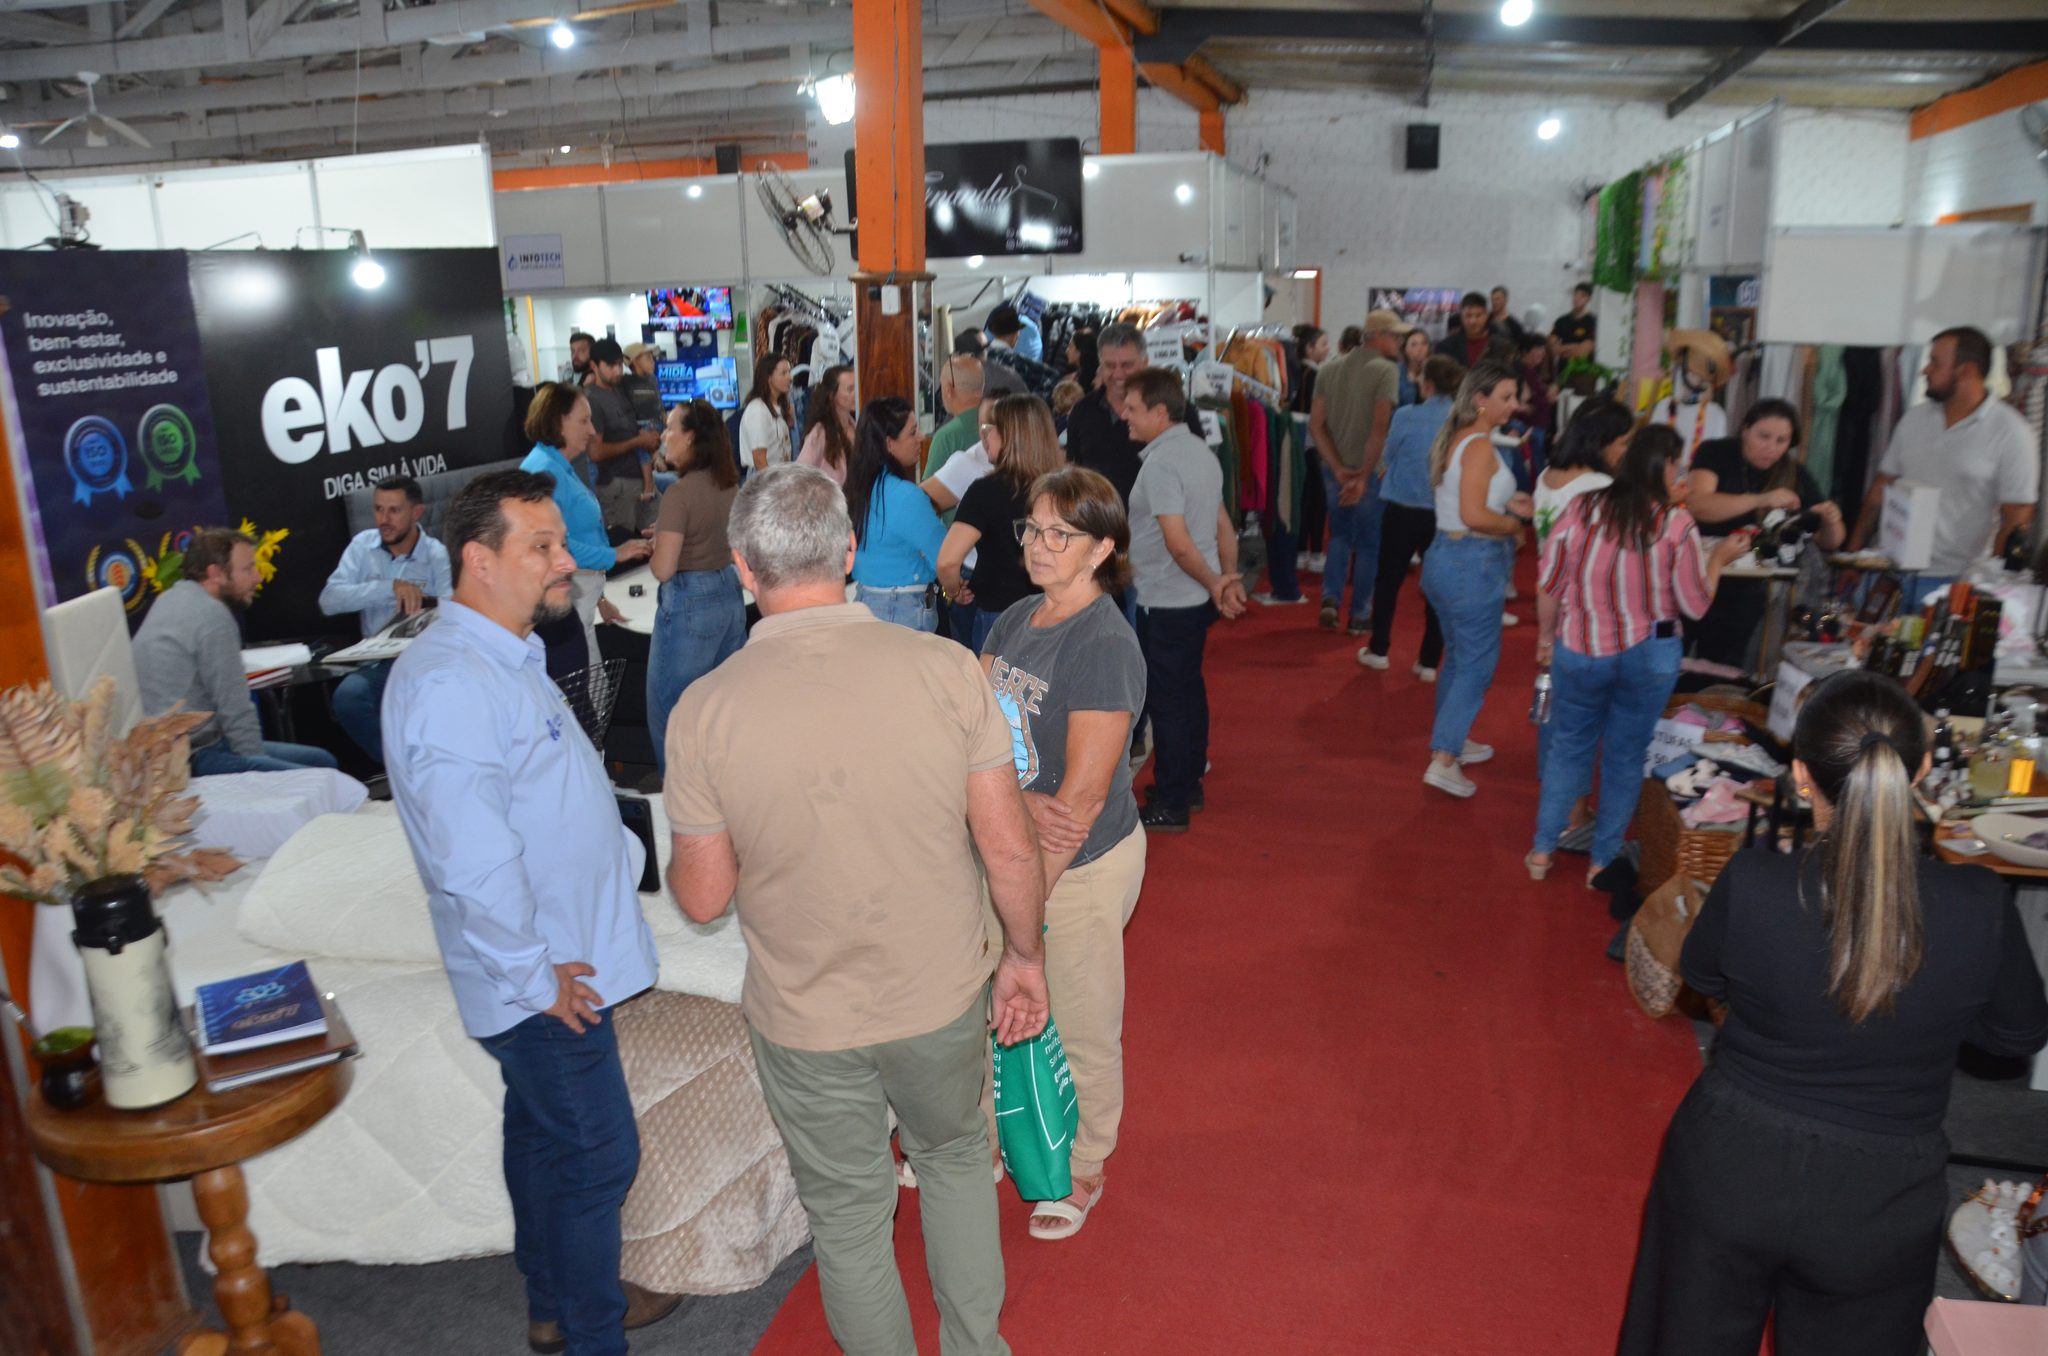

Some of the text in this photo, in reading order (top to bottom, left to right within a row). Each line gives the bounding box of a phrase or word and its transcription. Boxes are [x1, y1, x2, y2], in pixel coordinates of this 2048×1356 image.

[519, 252, 561, 263] INFOTECH
[23, 309, 114, 330] Inovação,
[27, 332, 126, 352] bem-estar,
[33, 350, 167, 374] exclusividade e
[658, 366, 694, 379] MIDEA
[37, 368, 178, 397] sustentabilidade
[323, 472, 366, 500] DIGA
[367, 463, 396, 488] SIM
[412, 453, 448, 479] VIDA
